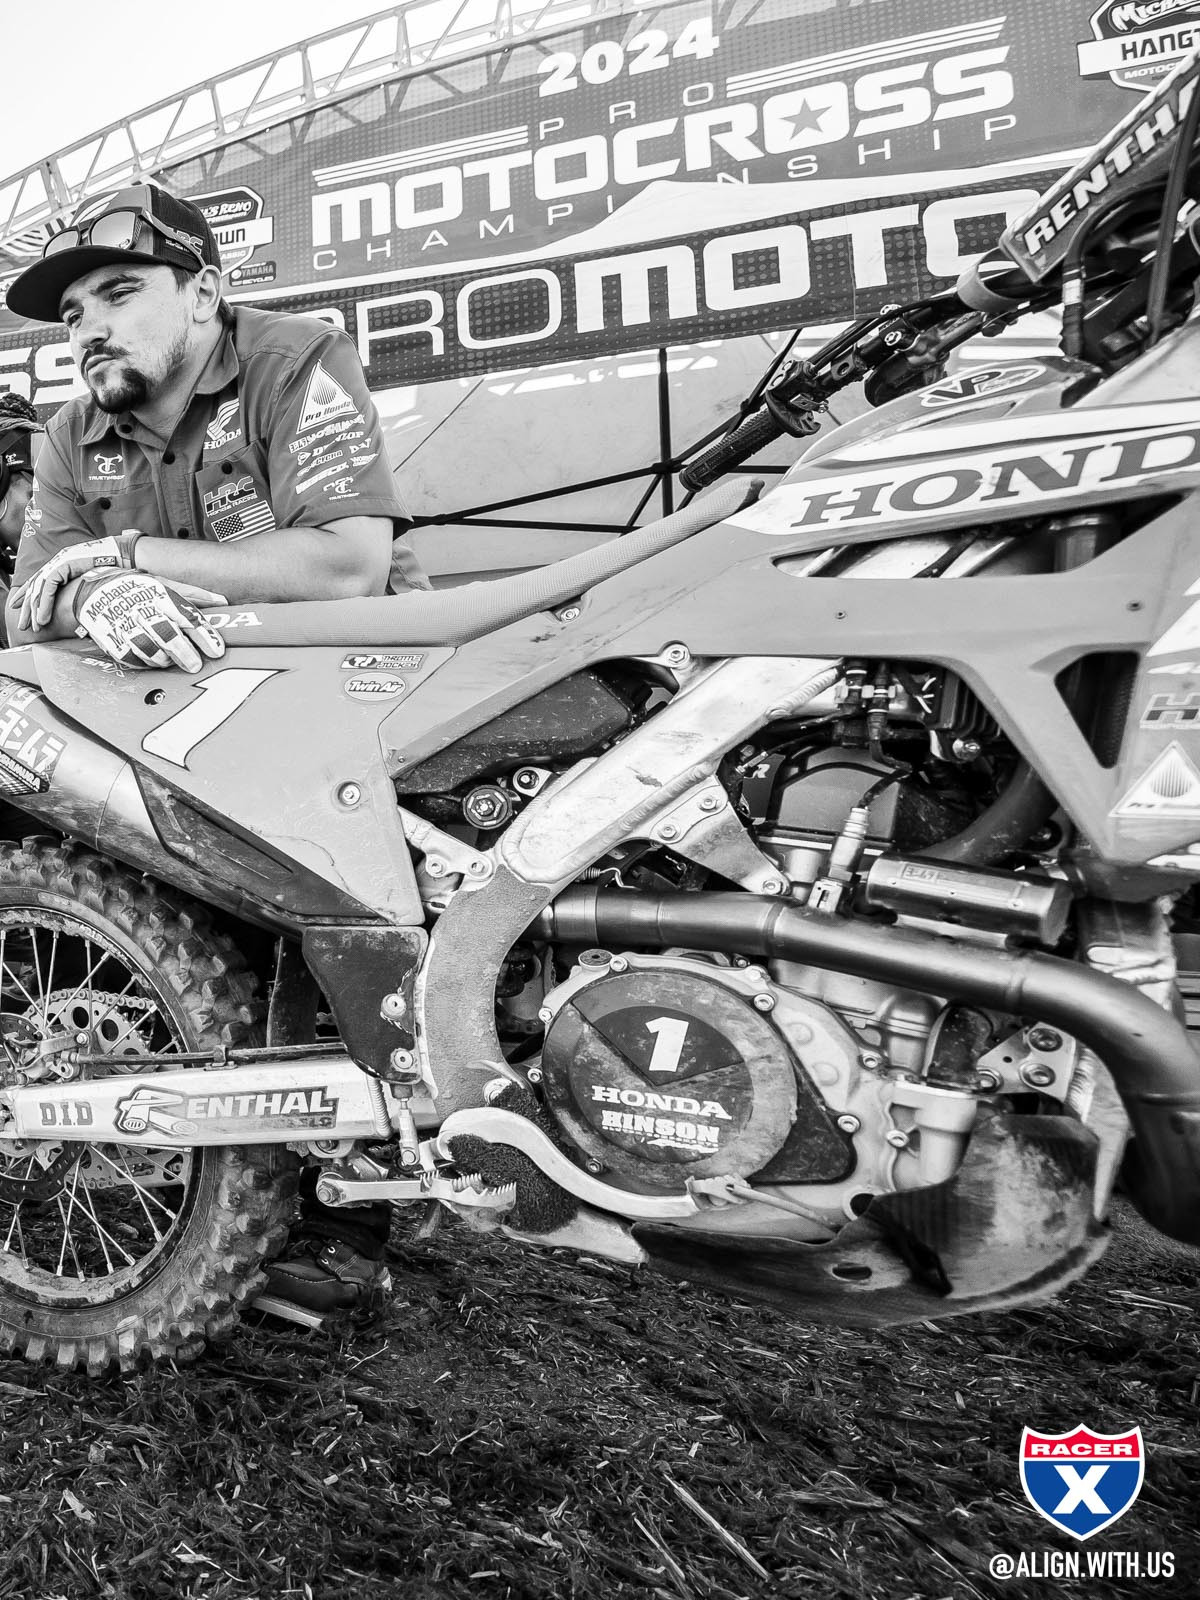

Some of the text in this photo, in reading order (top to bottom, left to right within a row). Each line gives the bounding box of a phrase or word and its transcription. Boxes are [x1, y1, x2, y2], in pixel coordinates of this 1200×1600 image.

[537, 15, 720, 98] 2024
[1121, 27, 1200, 61] HANG
[538, 81, 714, 141] PRO
[312, 46, 1014, 247] MOTOCROSS
[312, 114, 1017, 271] CHAMPINSHIP
[203, 427, 243, 450] HONDA
[86, 578, 139, 622] Mechanix
[101, 584, 161, 627] Mechanix
[348, 680, 404, 693] Twin Air
[141, 669, 289, 771] 1
[645, 1016, 690, 1073] 1
[591, 1085, 733, 1121] HONDA
[601, 1109, 720, 1144] HINSON
